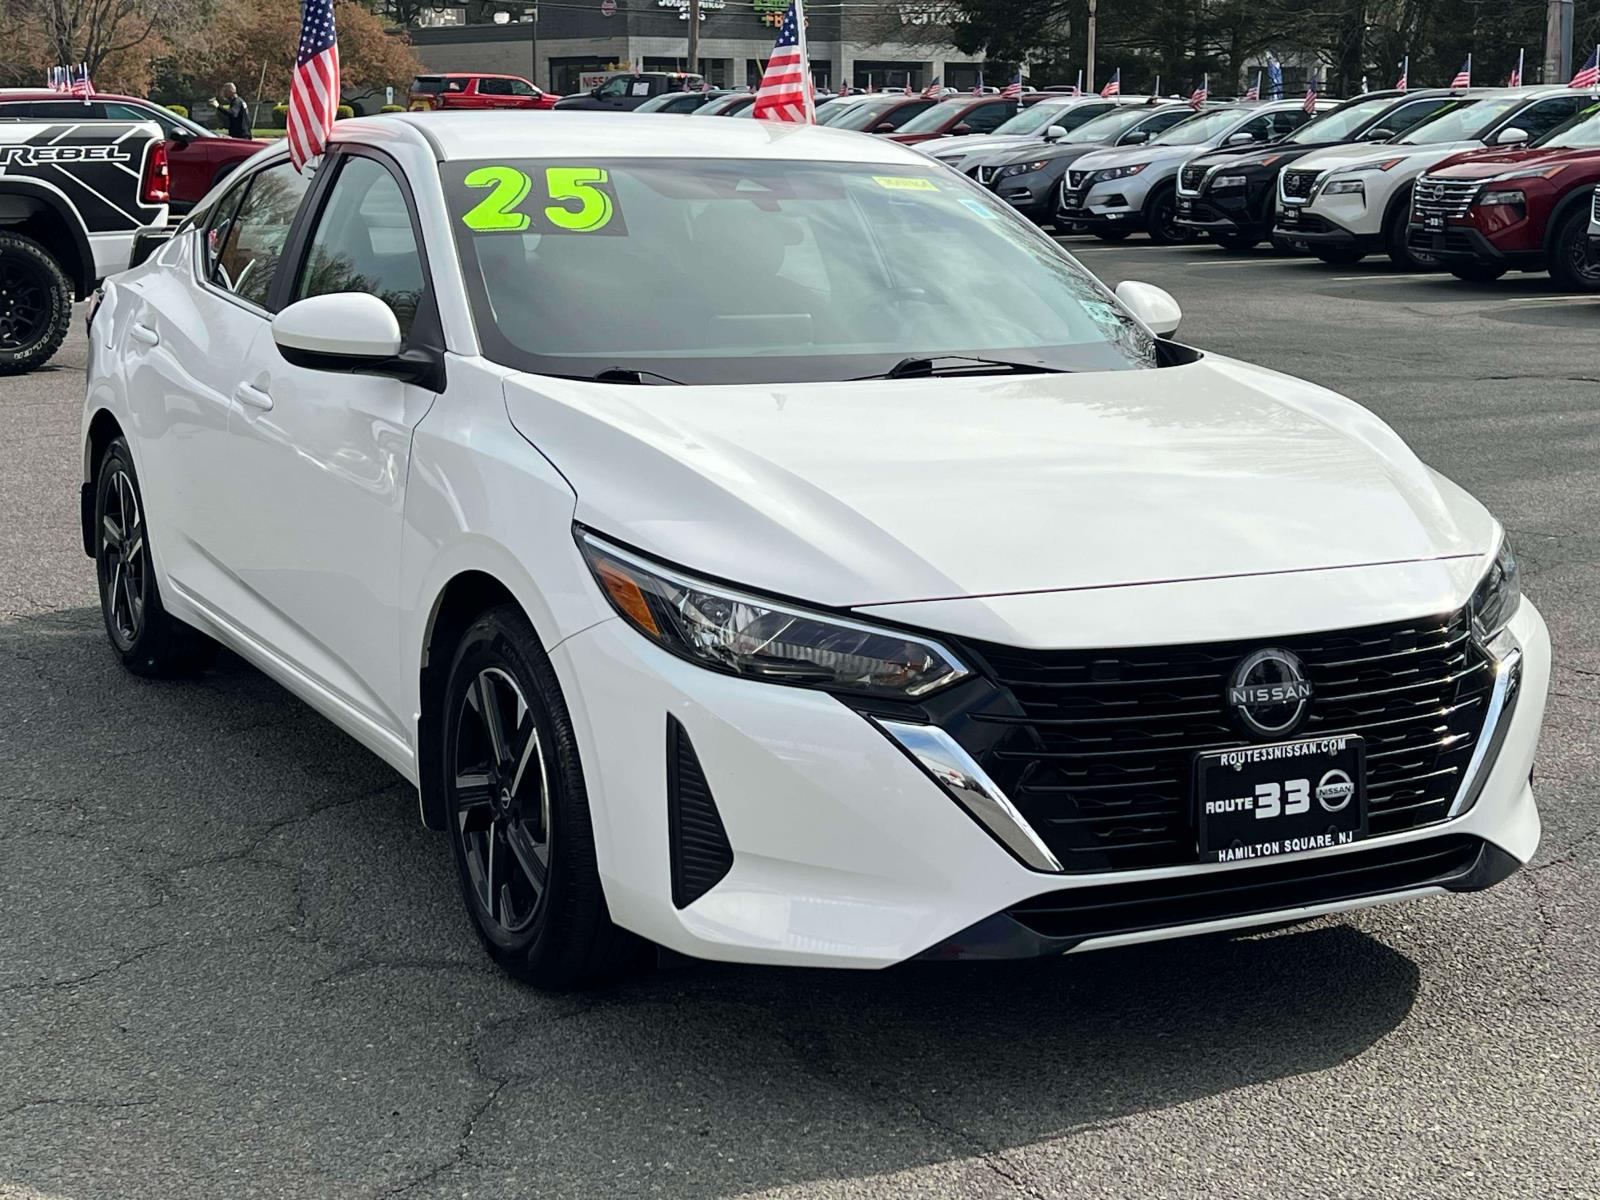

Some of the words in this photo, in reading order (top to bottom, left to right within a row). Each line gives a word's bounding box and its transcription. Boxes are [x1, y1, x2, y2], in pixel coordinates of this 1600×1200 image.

[0, 144, 131, 166] REBEL
[462, 166, 613, 232] 25
[1232, 684, 1310, 703] NISSAN
[1220, 738, 1346, 766] ROUTE33NISSAN.COM
[1206, 797, 1253, 814] ROUTE
[1255, 778, 1310, 819] 33
[1319, 785, 1351, 796] NISSAN
[1218, 842, 1280, 862] HAMILTON
[1284, 834, 1335, 852] SQUARE,
[1338, 831, 1353, 843] NJ
